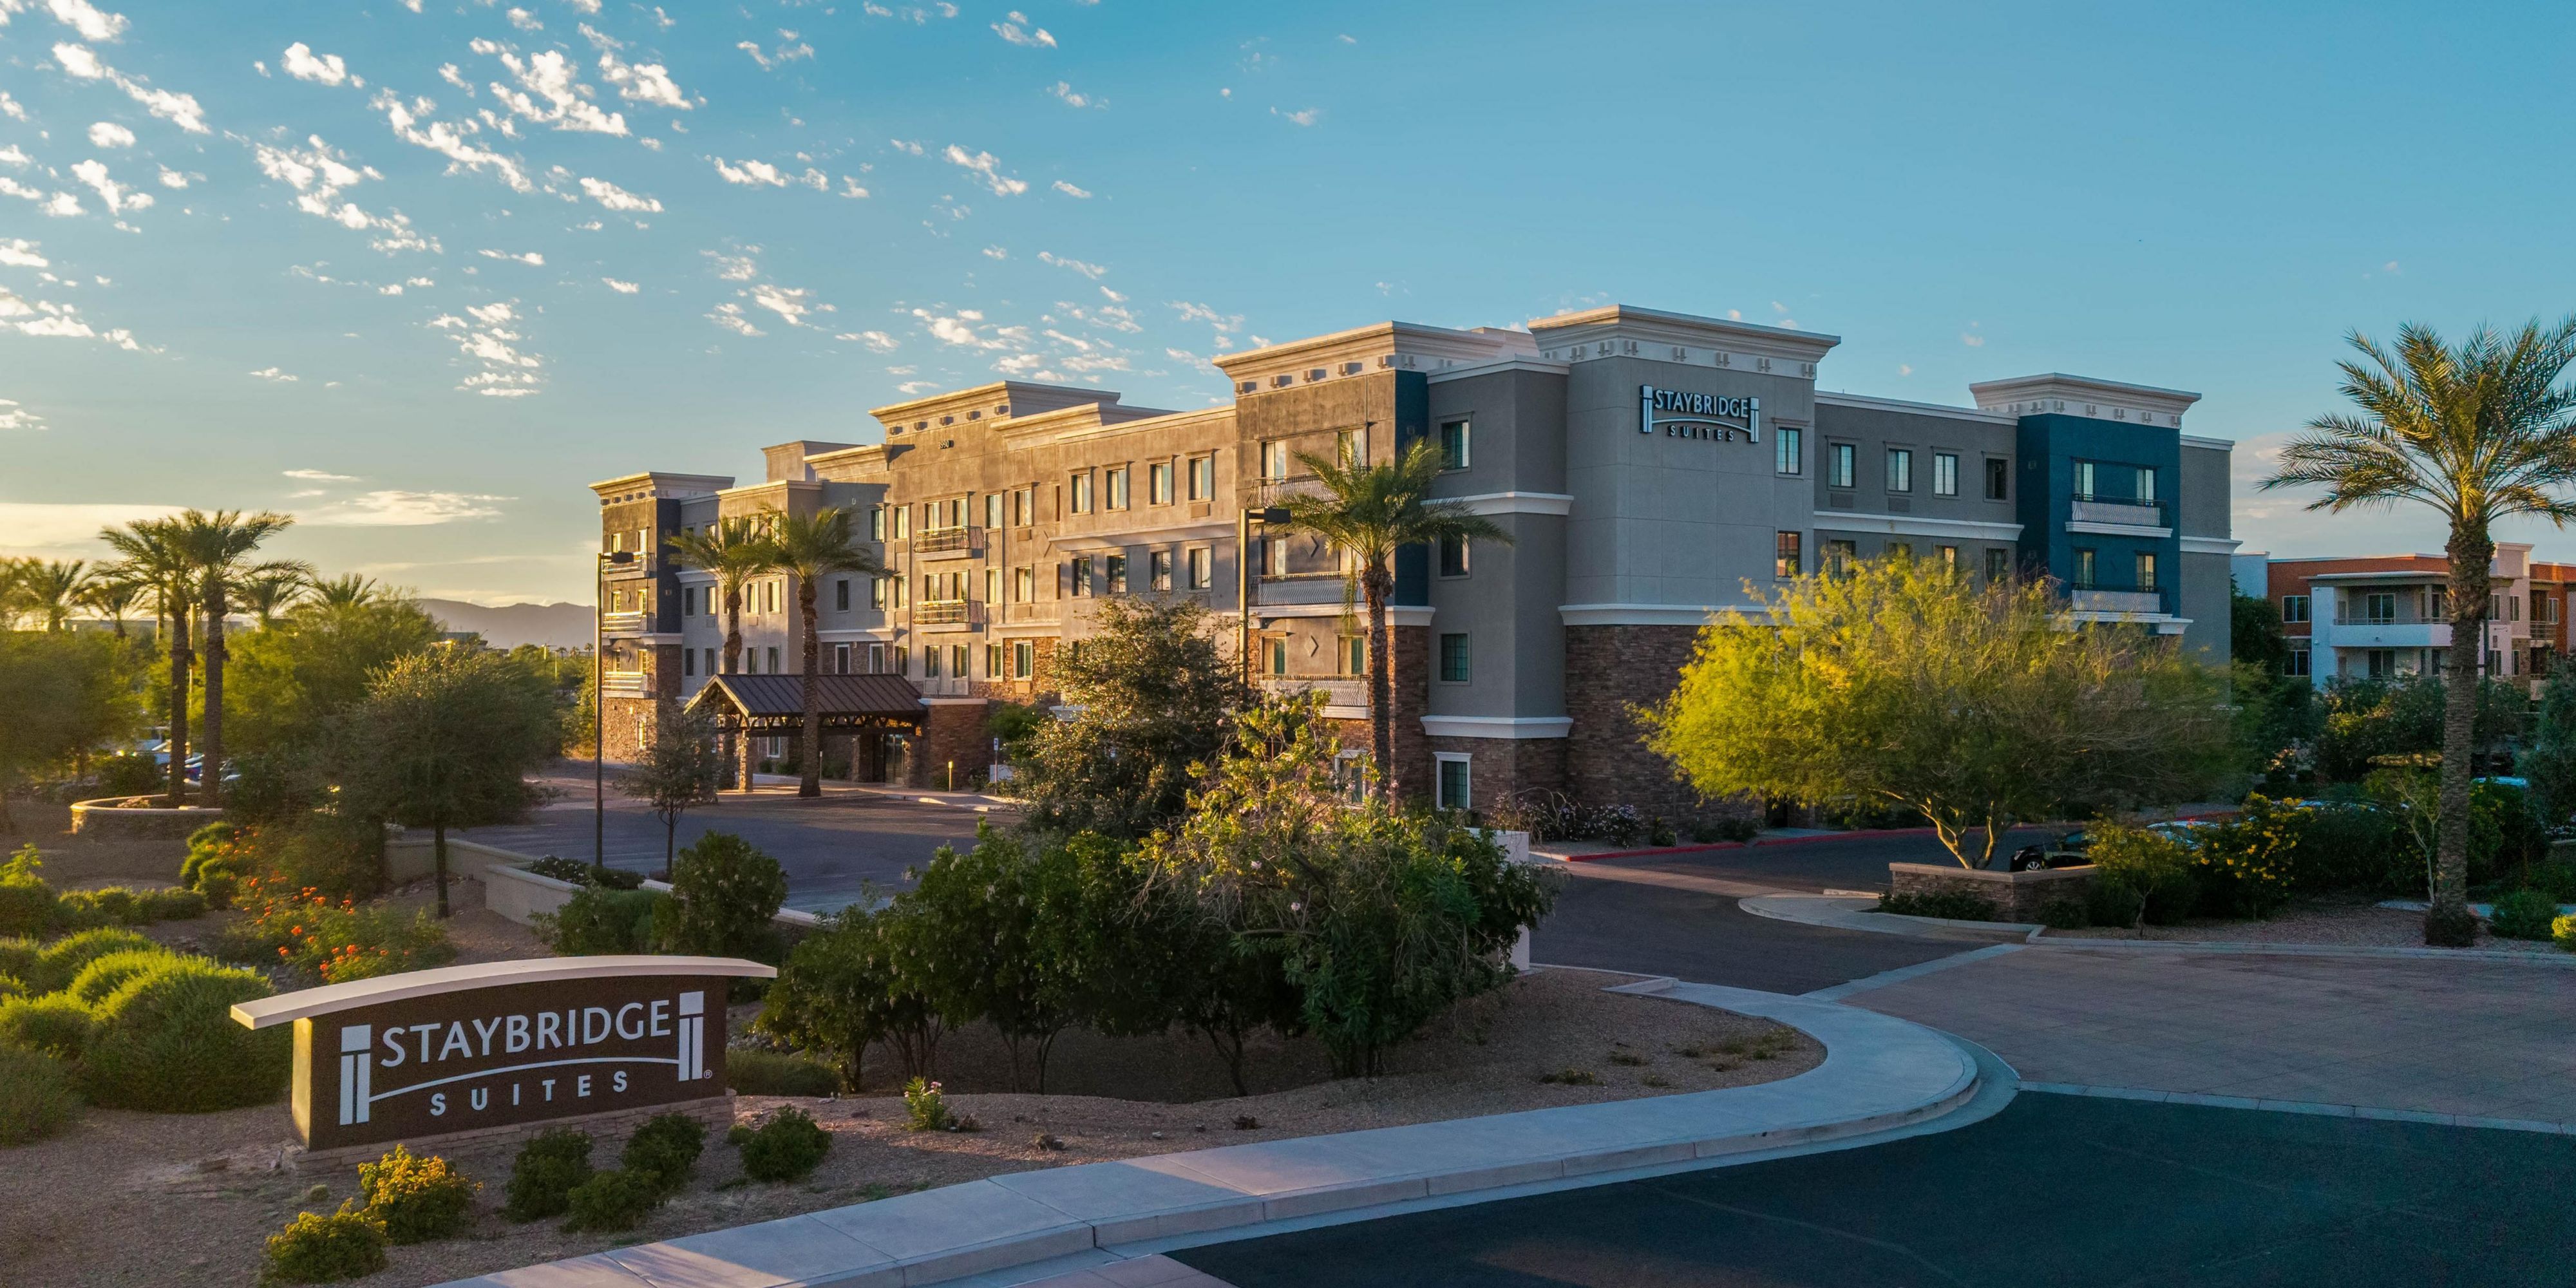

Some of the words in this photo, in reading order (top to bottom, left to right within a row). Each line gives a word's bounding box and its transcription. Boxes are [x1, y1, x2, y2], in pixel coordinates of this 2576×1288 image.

[1655, 390, 1748, 417] STAYBRIDGE
[1669, 425, 1734, 441] SUITES
[381, 999, 671, 1067] STAYBRIDGE
[430, 1070, 628, 1116] SUITES
